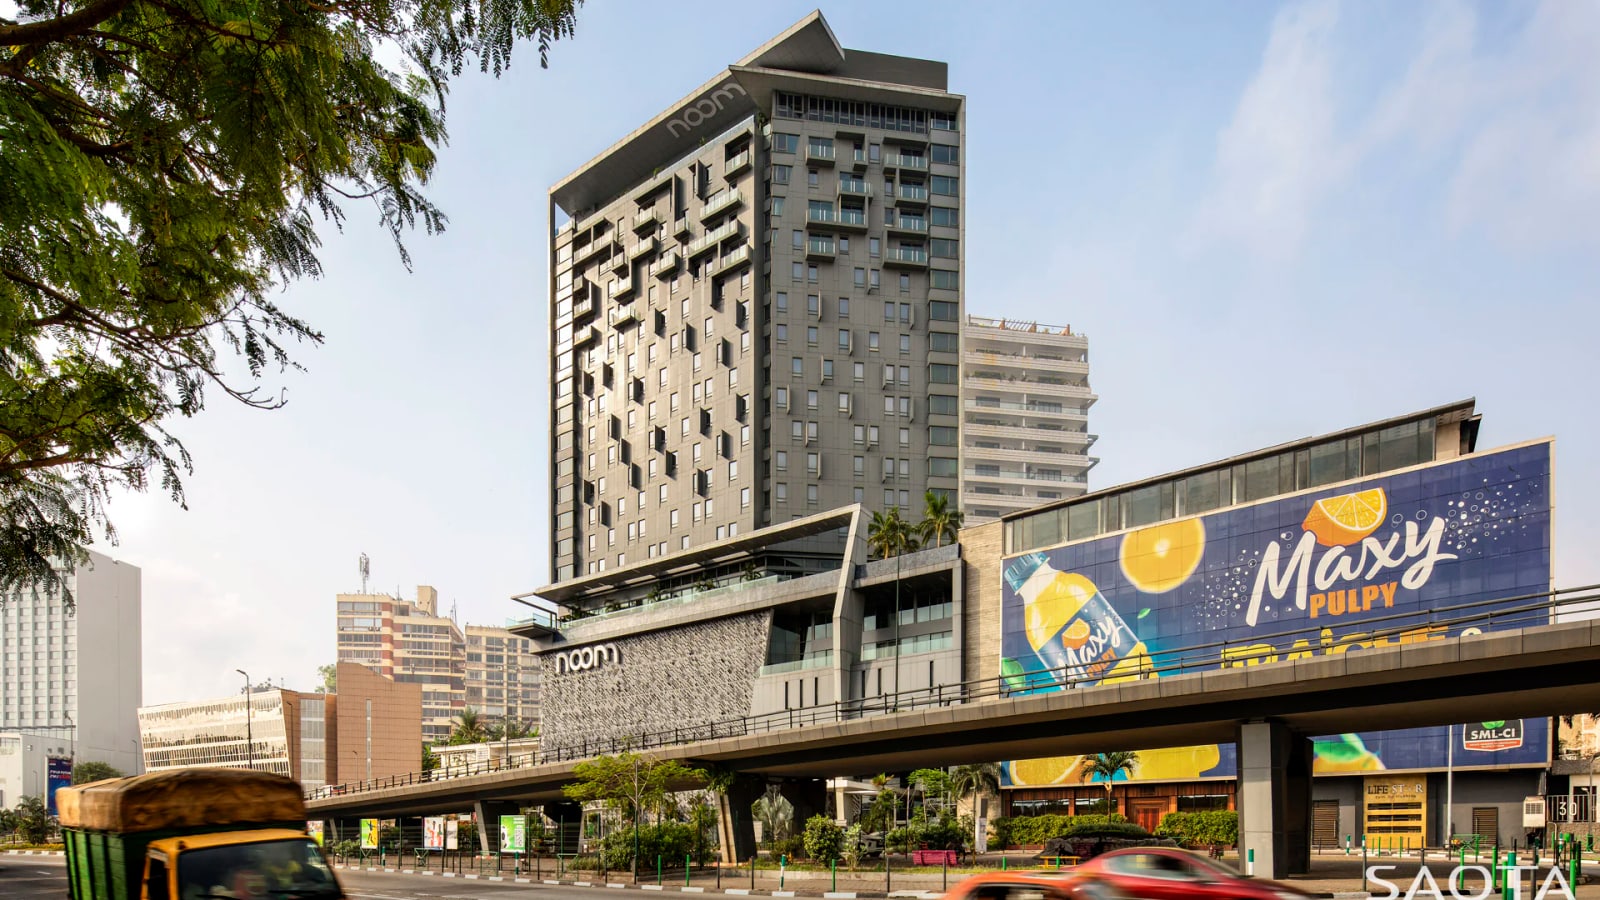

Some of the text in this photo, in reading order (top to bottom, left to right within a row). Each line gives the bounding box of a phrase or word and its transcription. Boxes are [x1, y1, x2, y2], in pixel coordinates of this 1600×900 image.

[666, 83, 747, 138] noom
[1245, 516, 1459, 627] Maxy
[1309, 581, 1398, 619] PULPY
[555, 643, 619, 673] noom
[1056, 615, 1124, 682] Maxy
[1471, 727, 1516, 740] SML-CI
[1367, 783, 1424, 795] LIFE STR
[1559, 801, 1577, 816] 30
